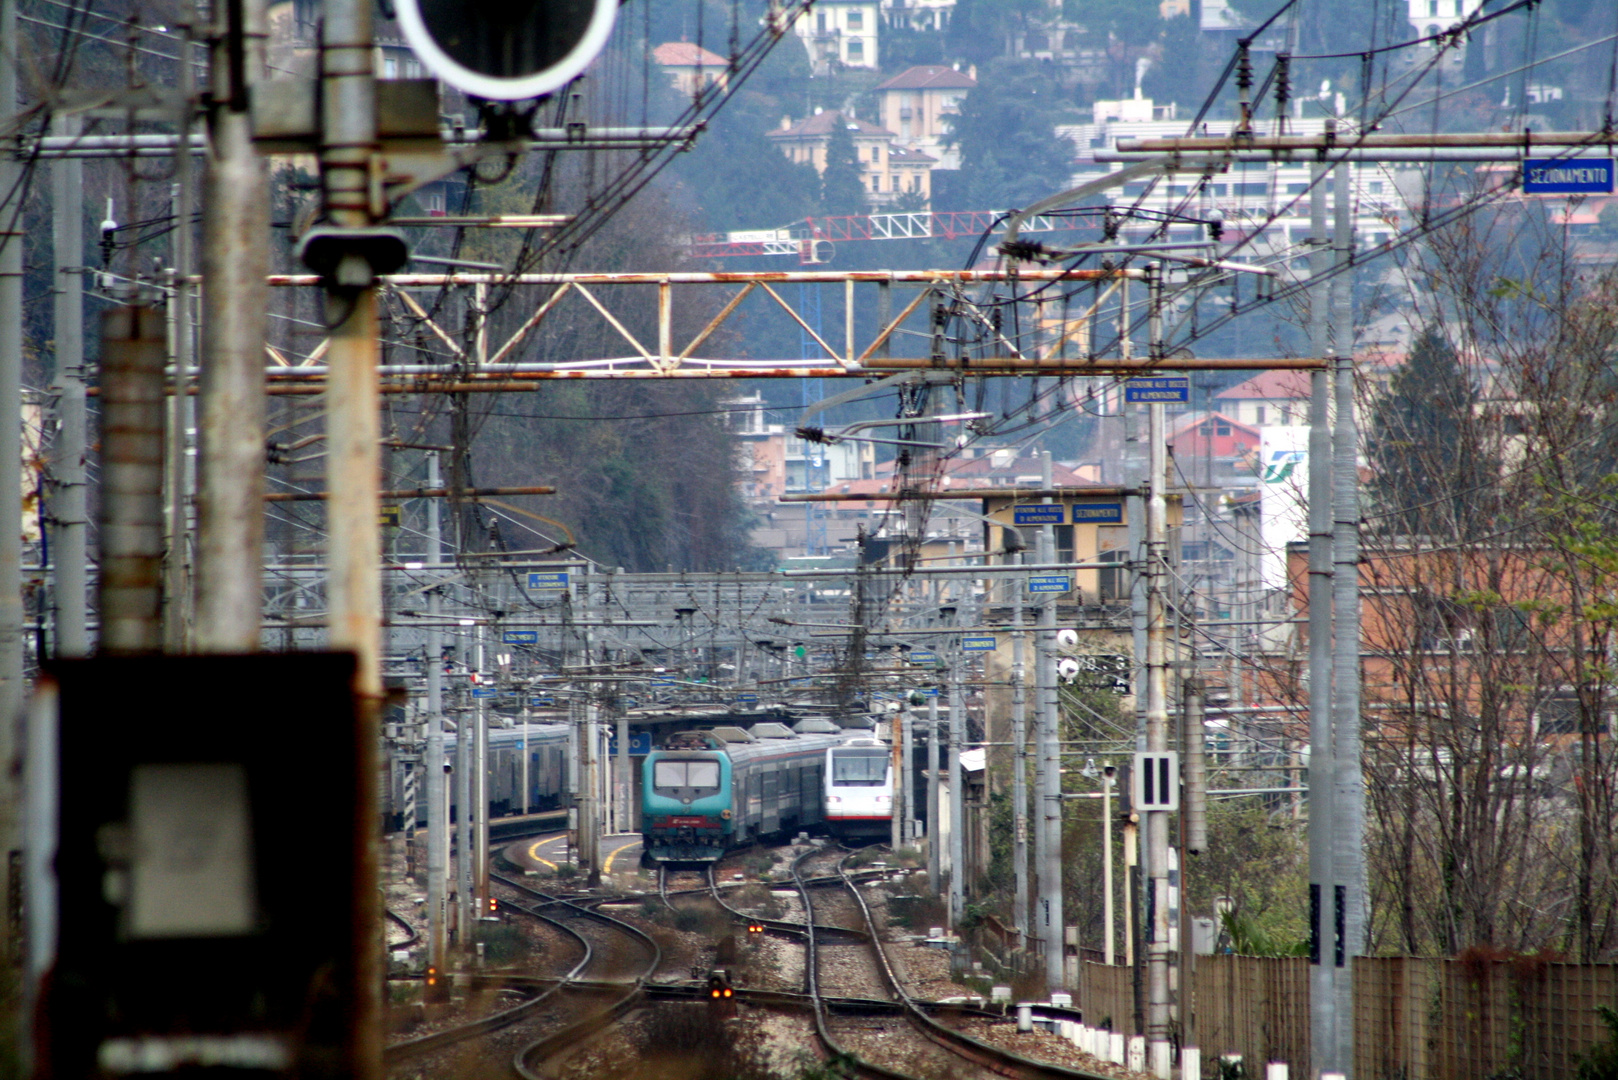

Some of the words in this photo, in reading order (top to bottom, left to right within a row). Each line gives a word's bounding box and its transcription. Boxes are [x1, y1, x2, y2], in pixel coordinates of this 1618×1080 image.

[1530, 168, 1607, 184] SEZIONAMENTO
[813, 457, 822, 467] 3
[1076, 509, 1118, 518] SEZIONAMENTO
